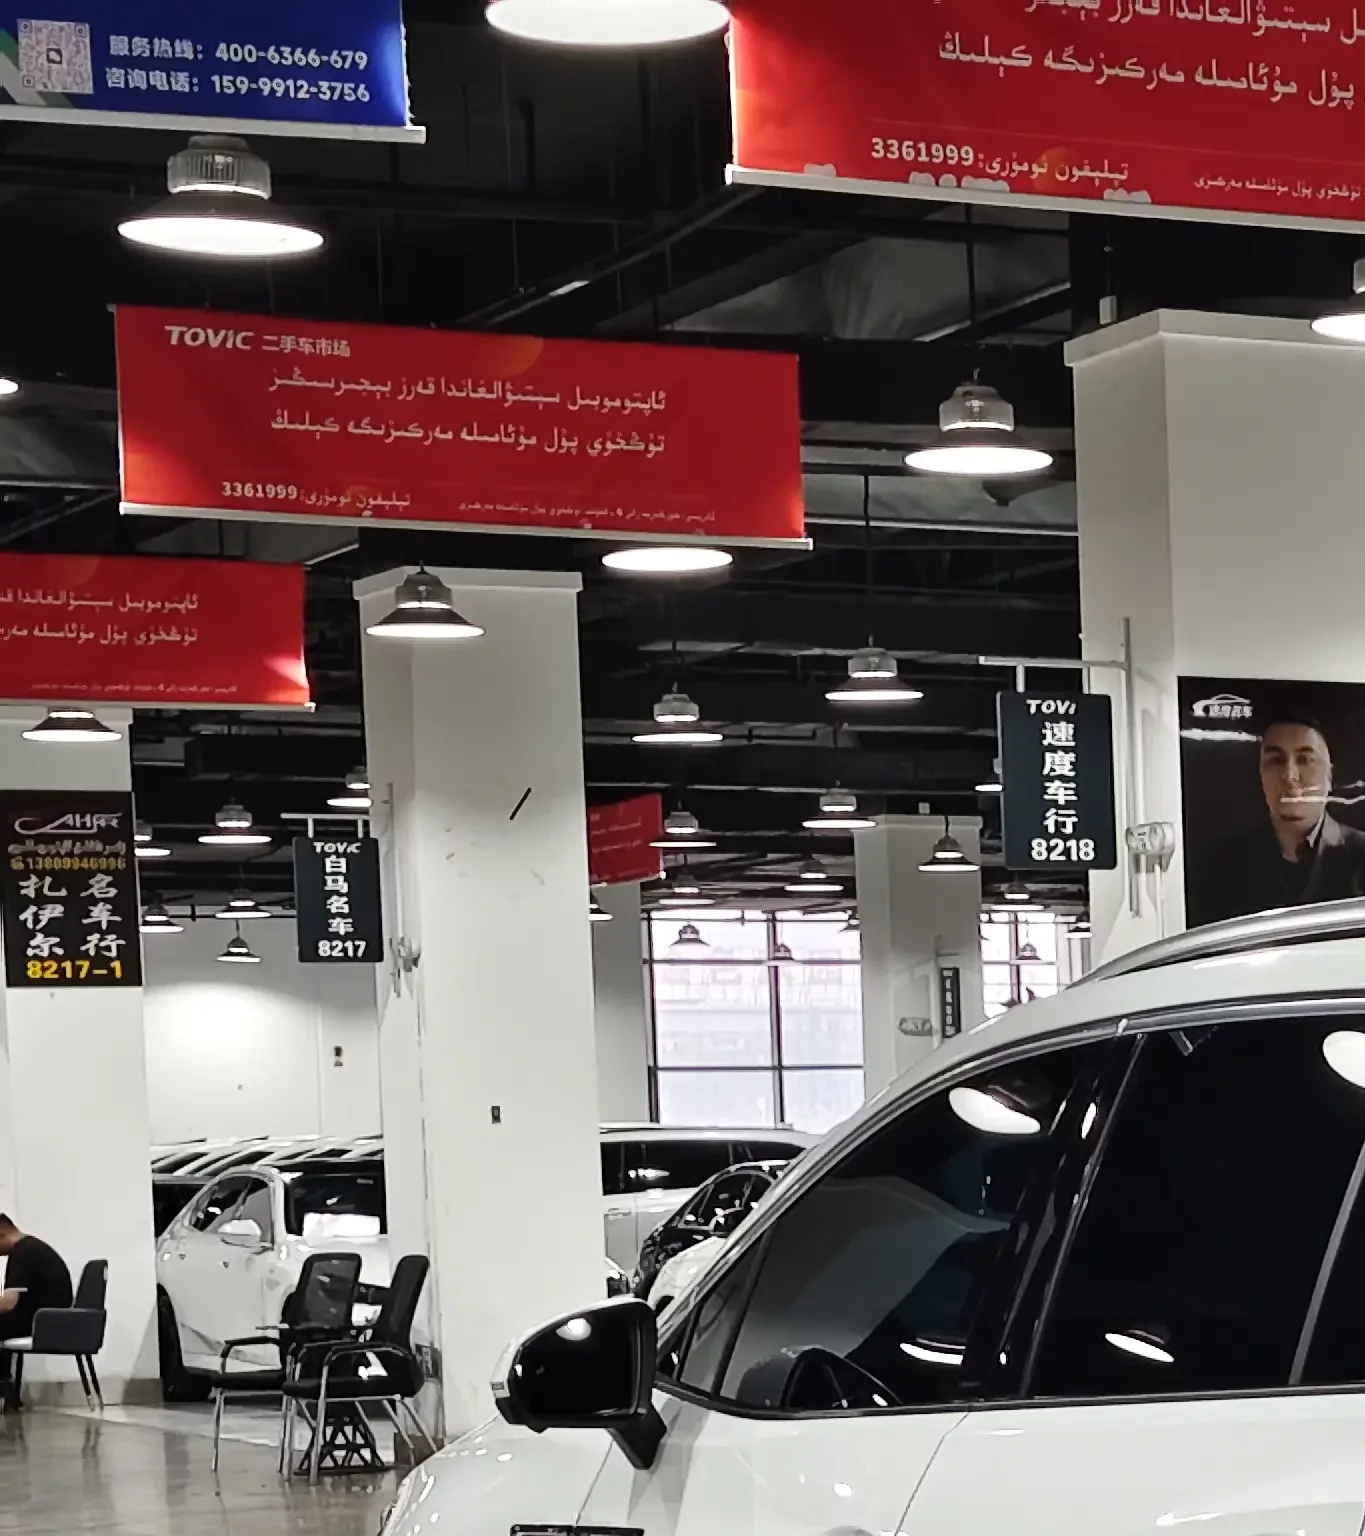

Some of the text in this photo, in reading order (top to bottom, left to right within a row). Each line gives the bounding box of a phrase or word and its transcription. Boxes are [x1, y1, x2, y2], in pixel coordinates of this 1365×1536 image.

[214, 42, 368, 71] 400-6366-679
[210, 75, 371, 103] 159-9912-3756
[870, 137, 975, 166] 3361999
[221, 481, 298, 500] 3361999
[1041, 720, 1079, 835] 速度车行
[1031, 837, 1095, 862] 8218
[323, 854, 355, 936] 白马名车
[317, 940, 367, 958] 8217
[26, 959, 123, 979] 8217-1
